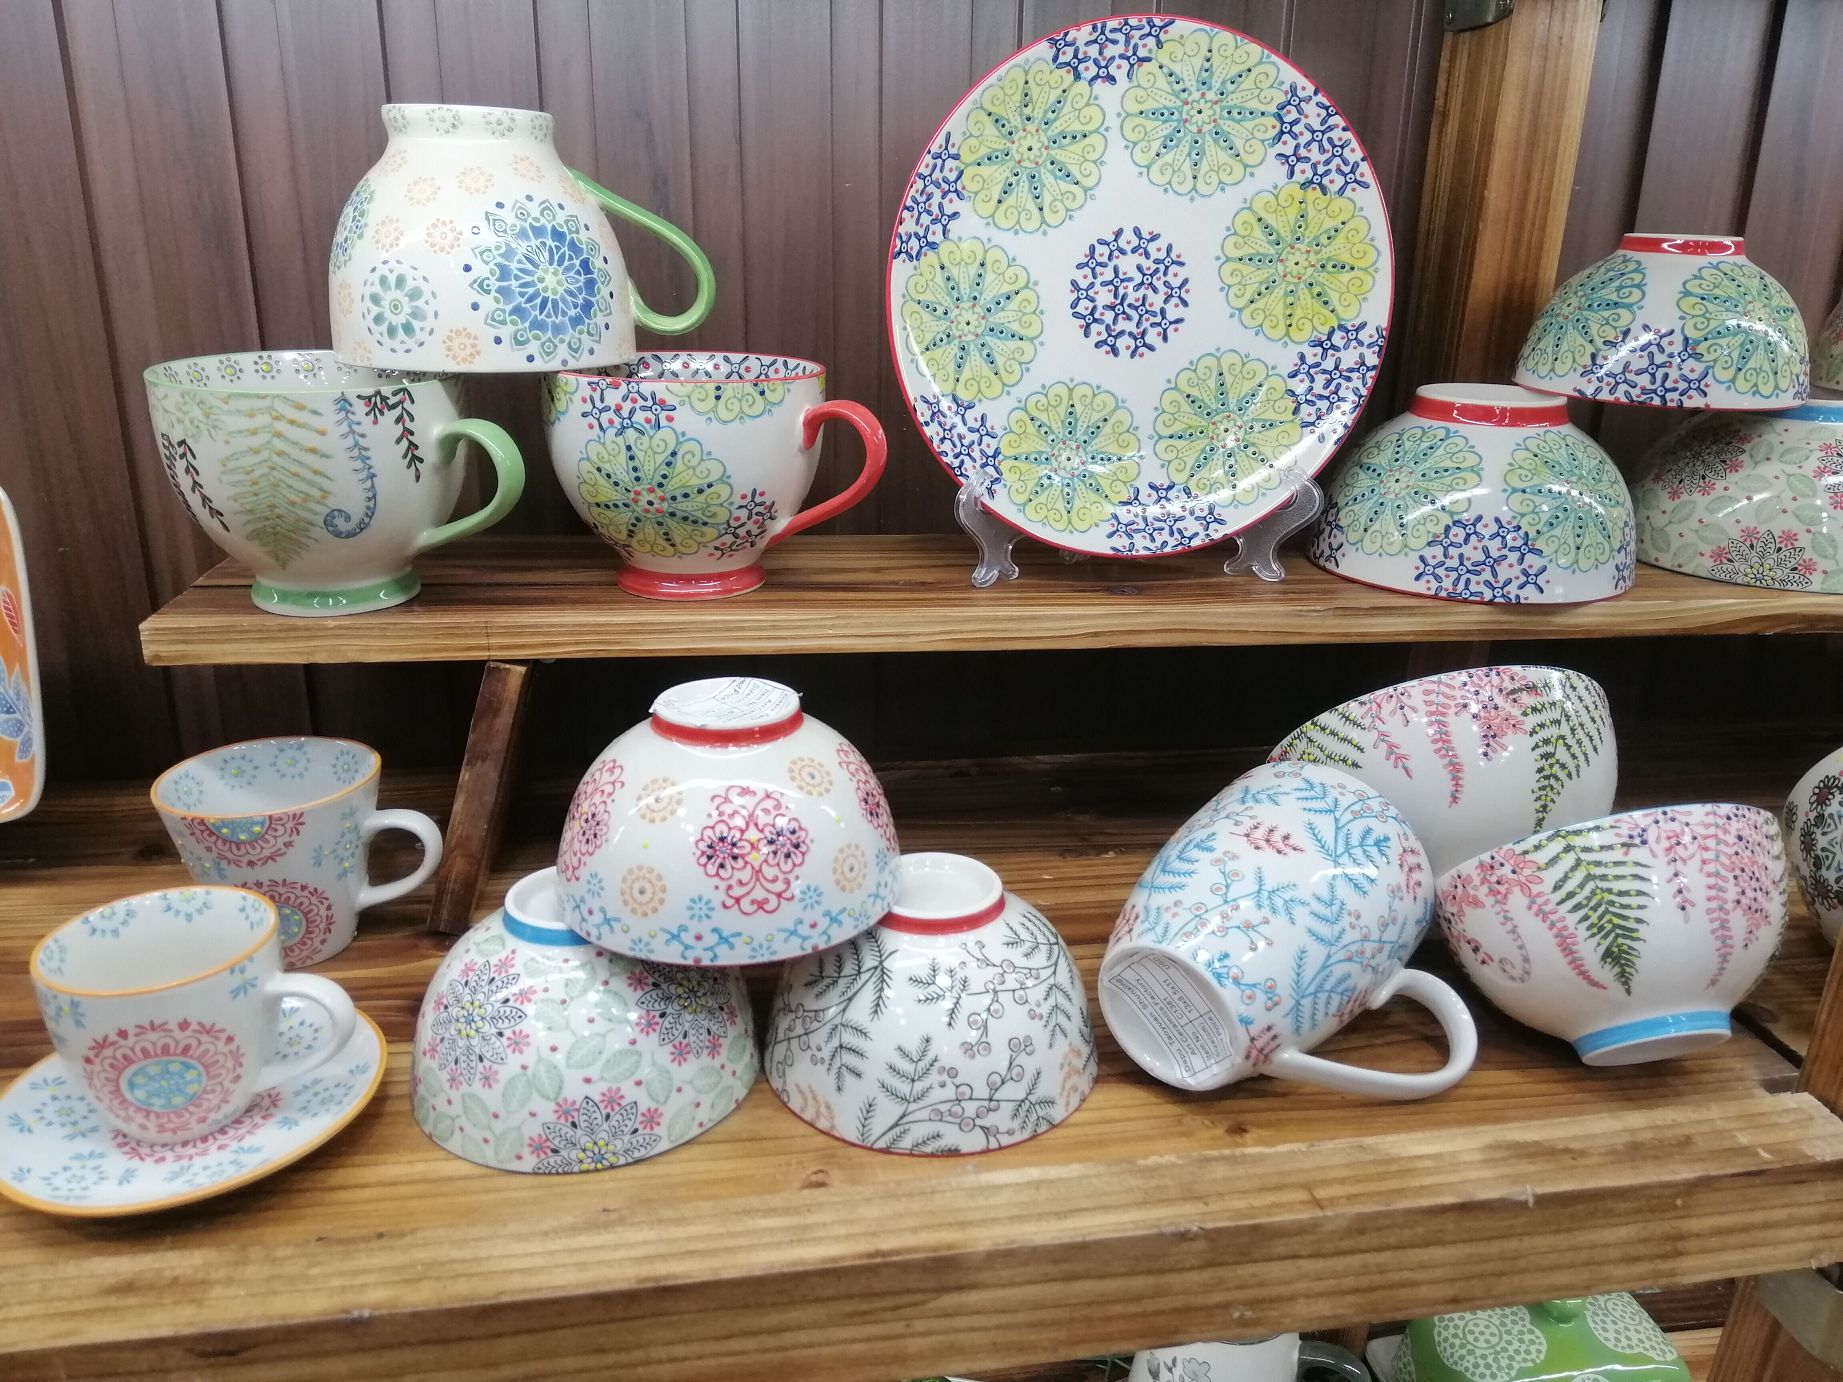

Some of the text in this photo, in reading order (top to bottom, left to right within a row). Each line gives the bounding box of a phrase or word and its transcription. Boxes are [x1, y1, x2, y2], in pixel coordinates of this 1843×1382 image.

[1115, 978, 1191, 1072] Dapu Taoyuan Shunxing
[1135, 979, 1198, 1055] Art Ceramics Factory
[1190, 1031, 1201, 1043] No
[1207, 1016, 1222, 1037] Price
